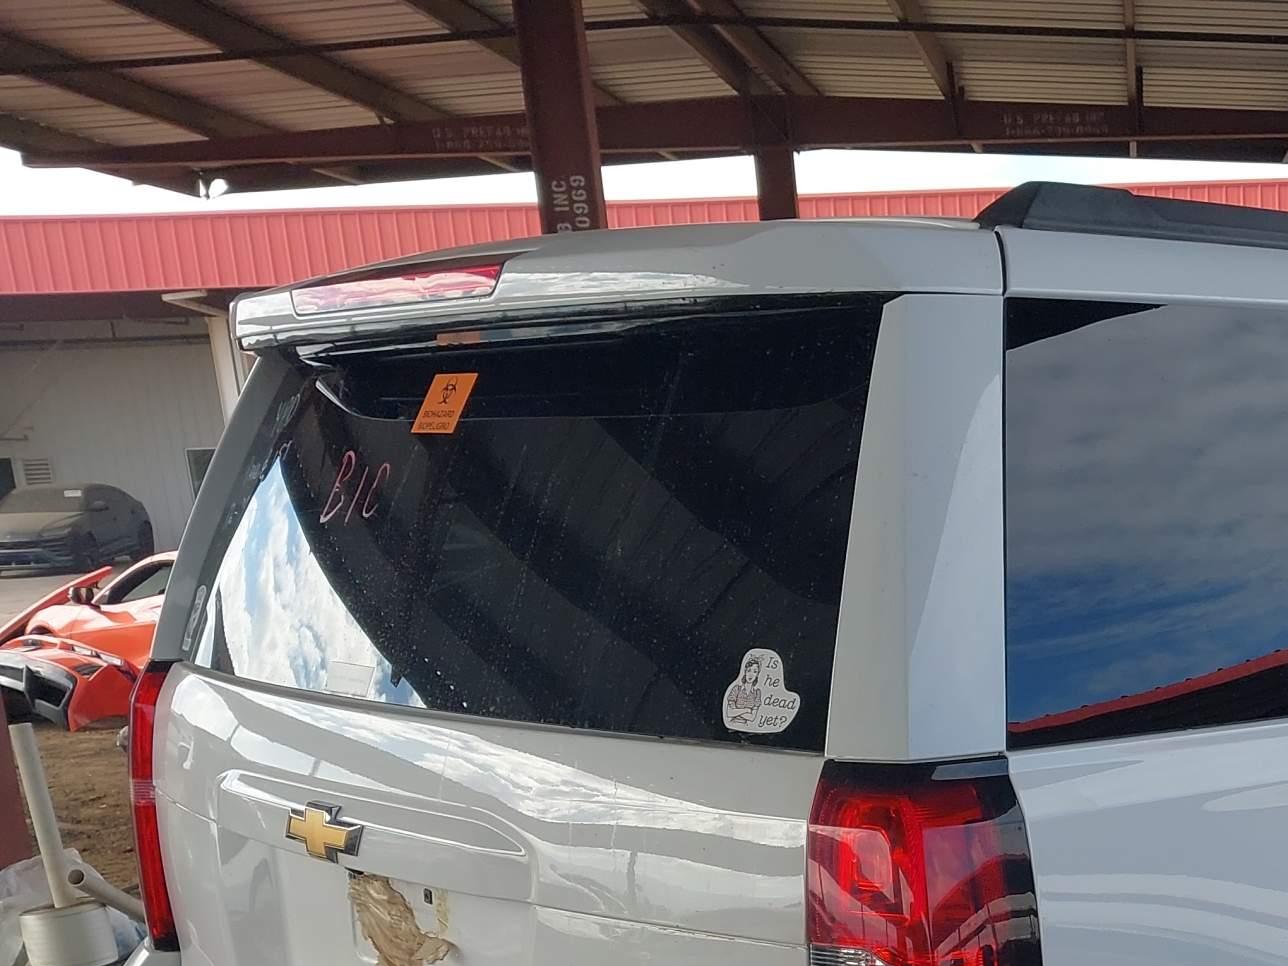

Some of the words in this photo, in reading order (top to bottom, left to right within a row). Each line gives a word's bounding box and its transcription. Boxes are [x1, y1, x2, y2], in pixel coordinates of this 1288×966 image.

[766, 656, 779, 669] Is
[764, 674, 780, 687] he
[764, 694, 796, 710] dead
[758, 715, 787, 728] yet?
